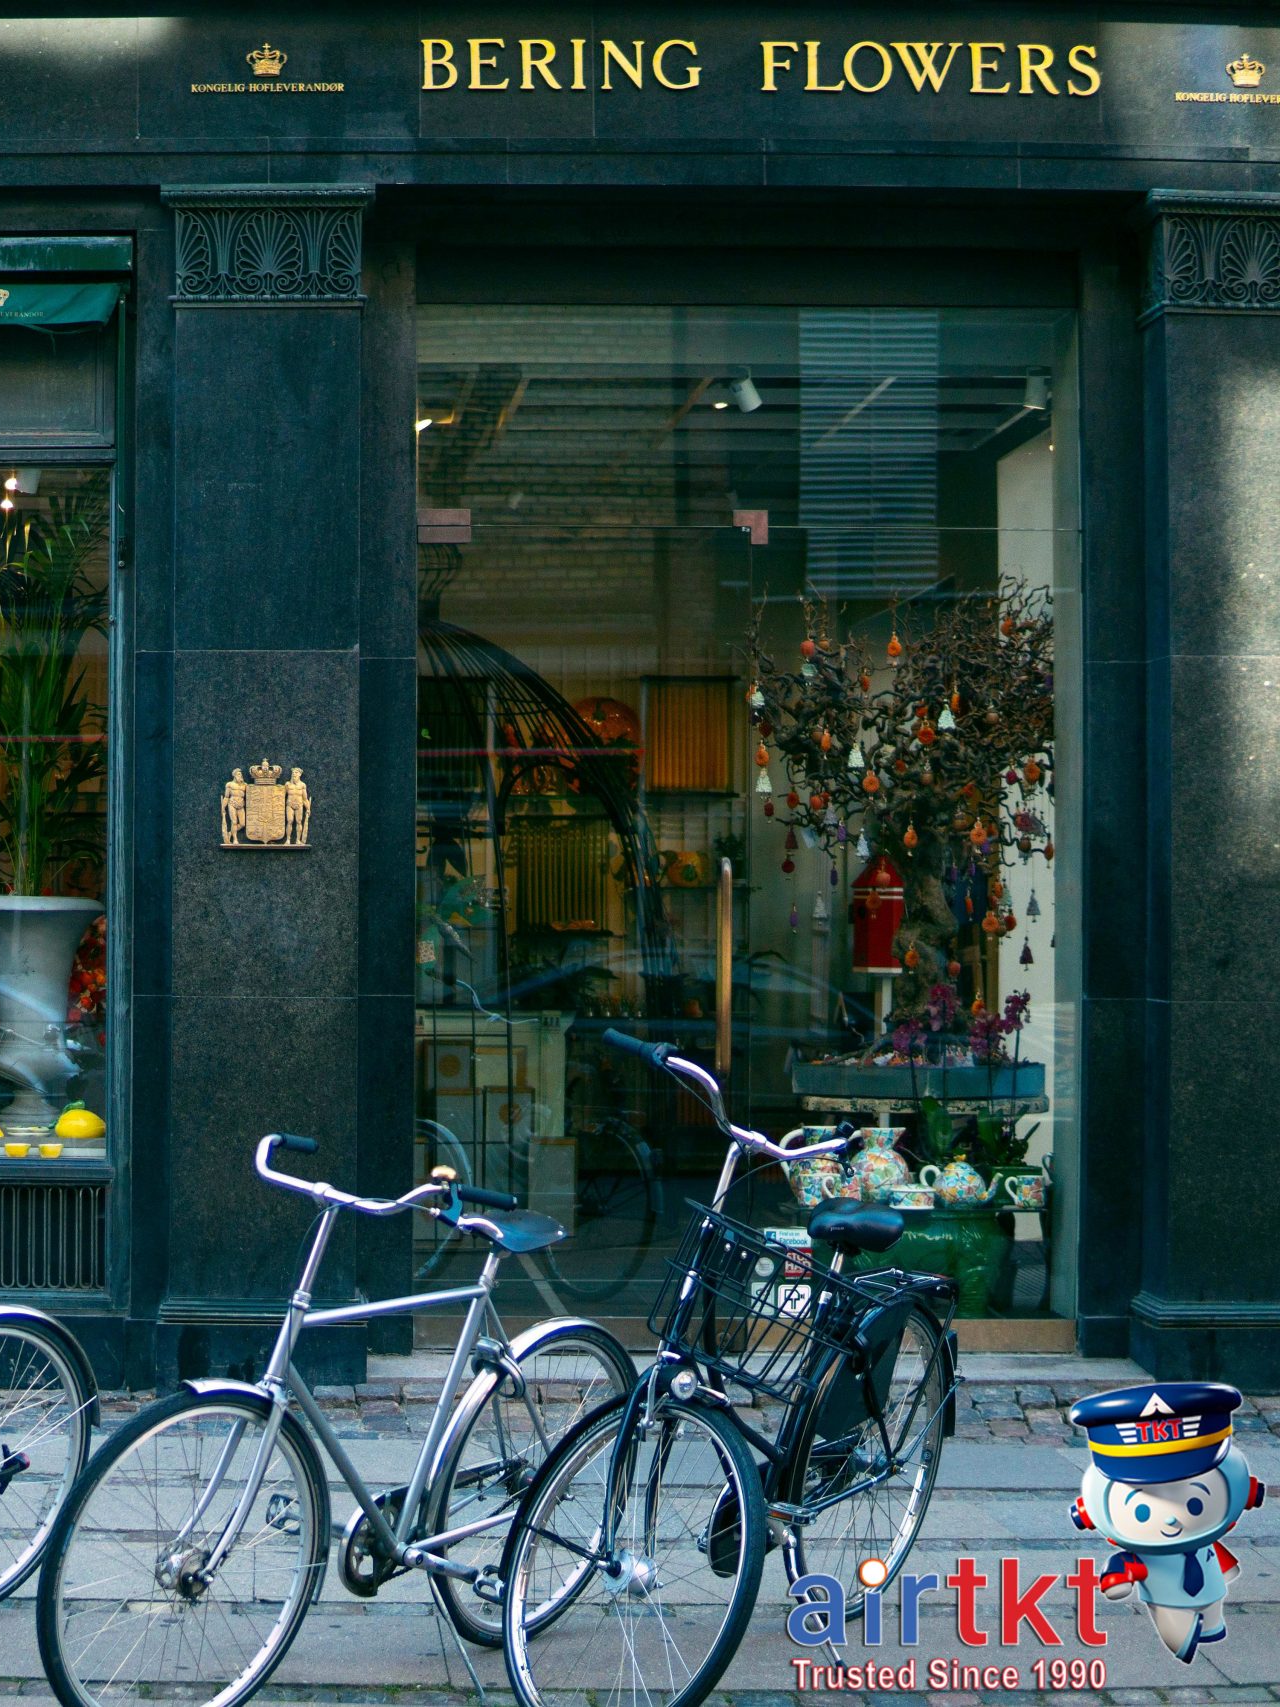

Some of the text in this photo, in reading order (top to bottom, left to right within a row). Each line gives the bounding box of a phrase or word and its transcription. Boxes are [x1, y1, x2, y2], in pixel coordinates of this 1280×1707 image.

[420, 38, 1101, 97] BERING FLOWERS
[191, 82, 345, 93] KONGELIG HOFLEVERANDØR
[1175, 92, 1227, 102] KONGELIG
